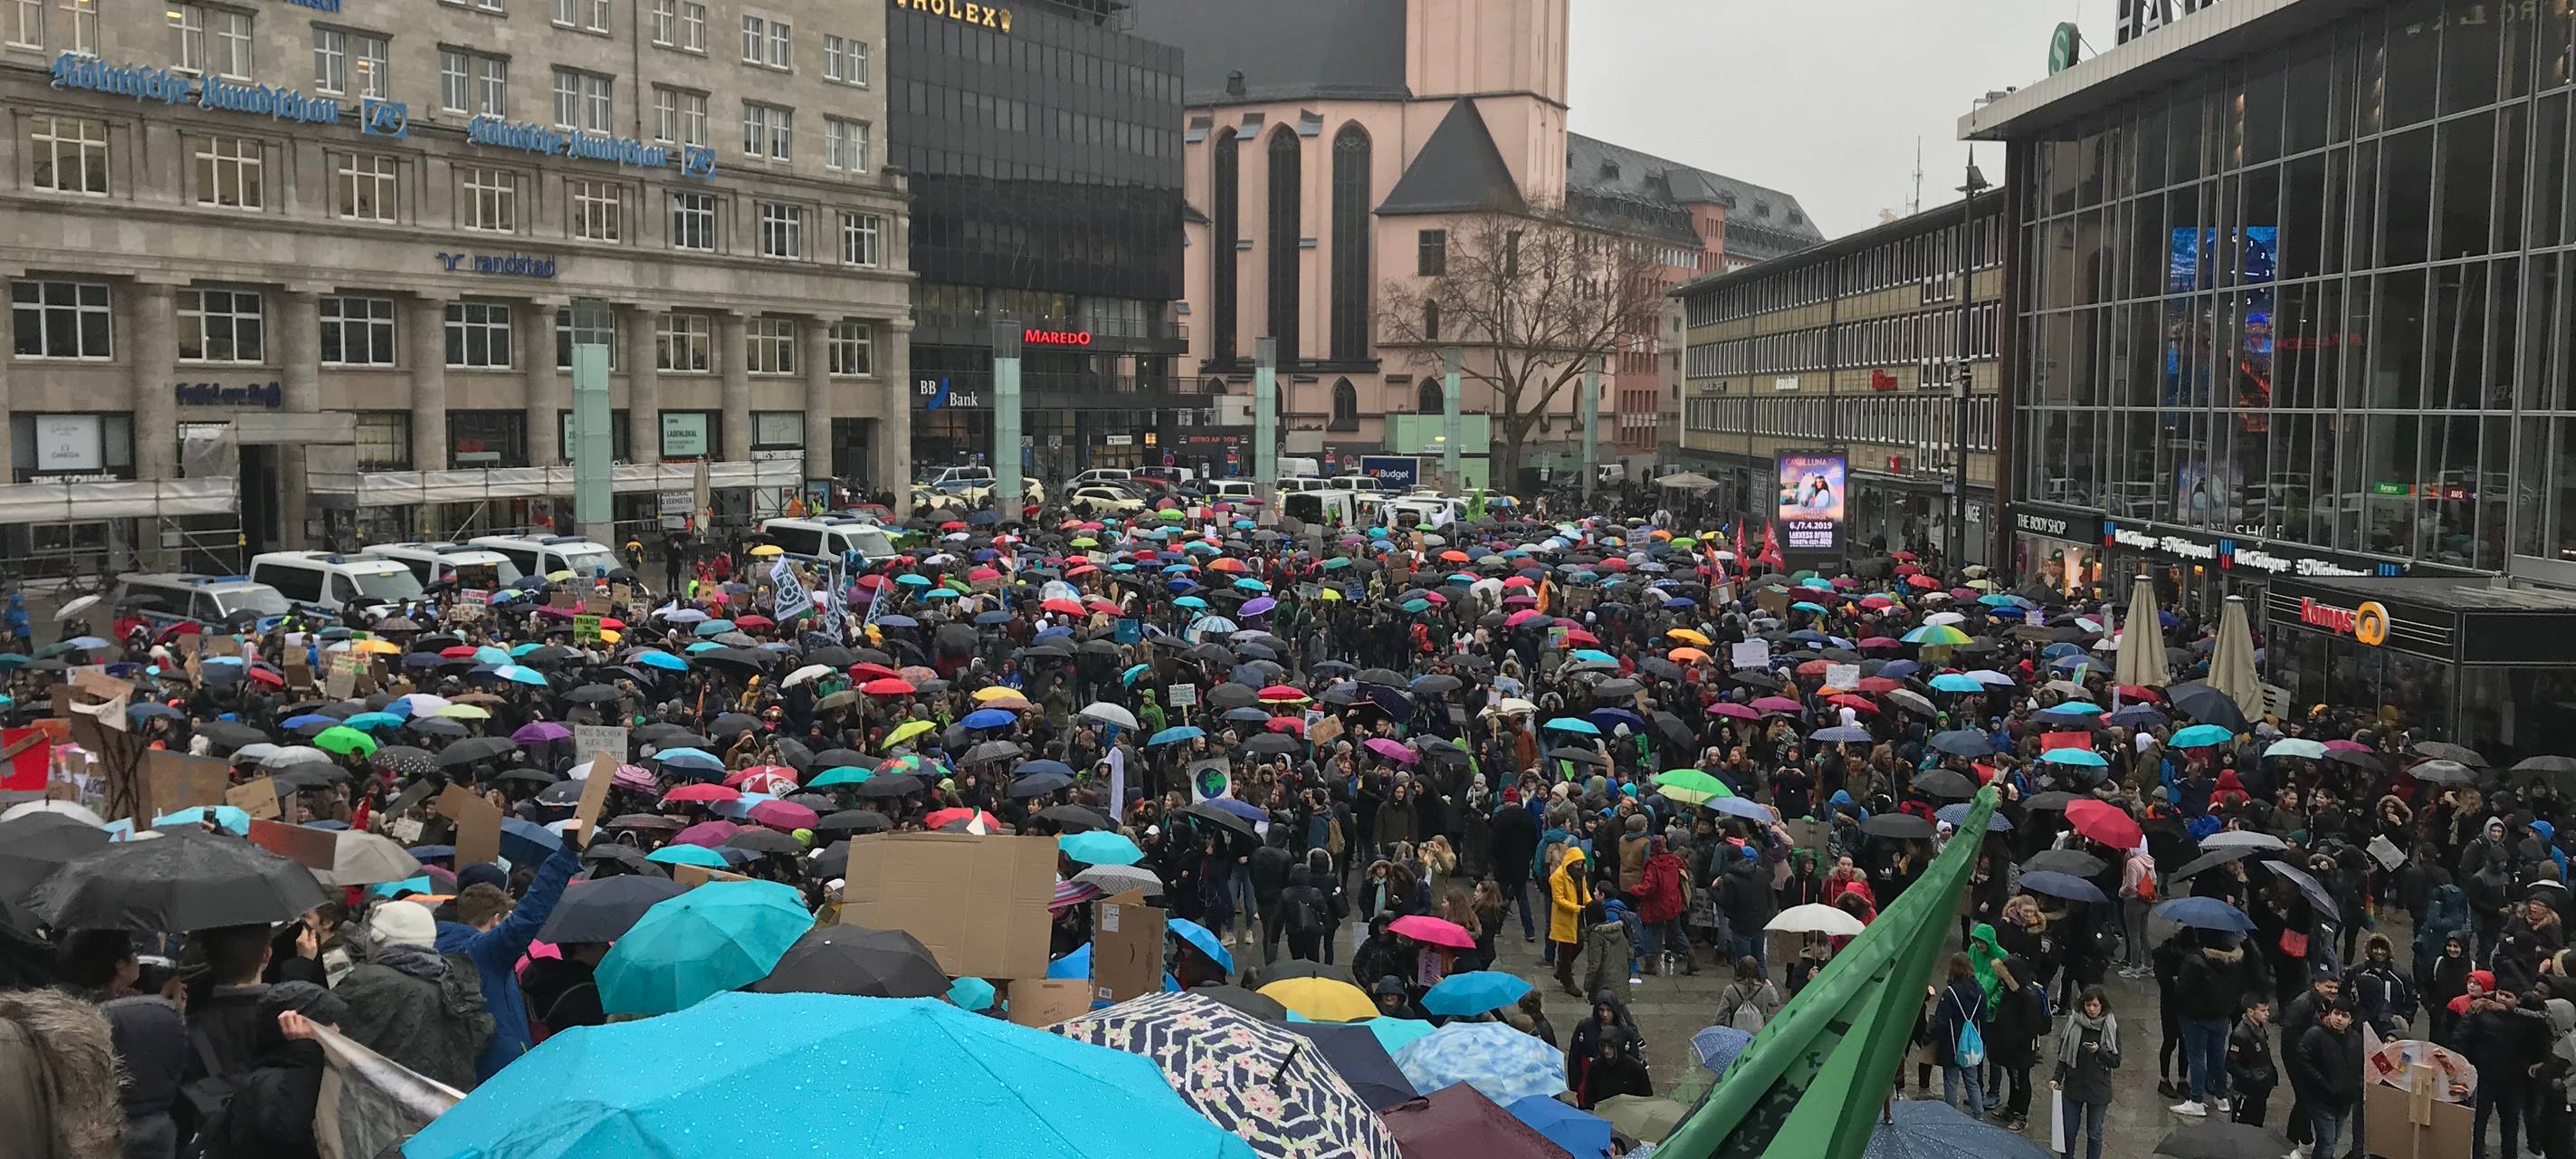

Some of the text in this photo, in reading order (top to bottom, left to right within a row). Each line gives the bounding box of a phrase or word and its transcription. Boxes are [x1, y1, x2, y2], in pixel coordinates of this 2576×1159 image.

[51, 52, 339, 124] Kölnische Rundschau
[472, 250, 556, 276] randstad
[1024, 328, 1092, 346] MAREDO
[920, 378, 937, 395] BB
[949, 391, 978, 407] Bank
[1380, 469, 1409, 481] Budget
[2018, 513, 2066, 535] THE BODY SHOP
[2114, 529, 2218, 559] NetCologne Highspeed
[2234, 548, 2292, 574] NetCologne
[2301, 596, 2353, 635] Kamps
